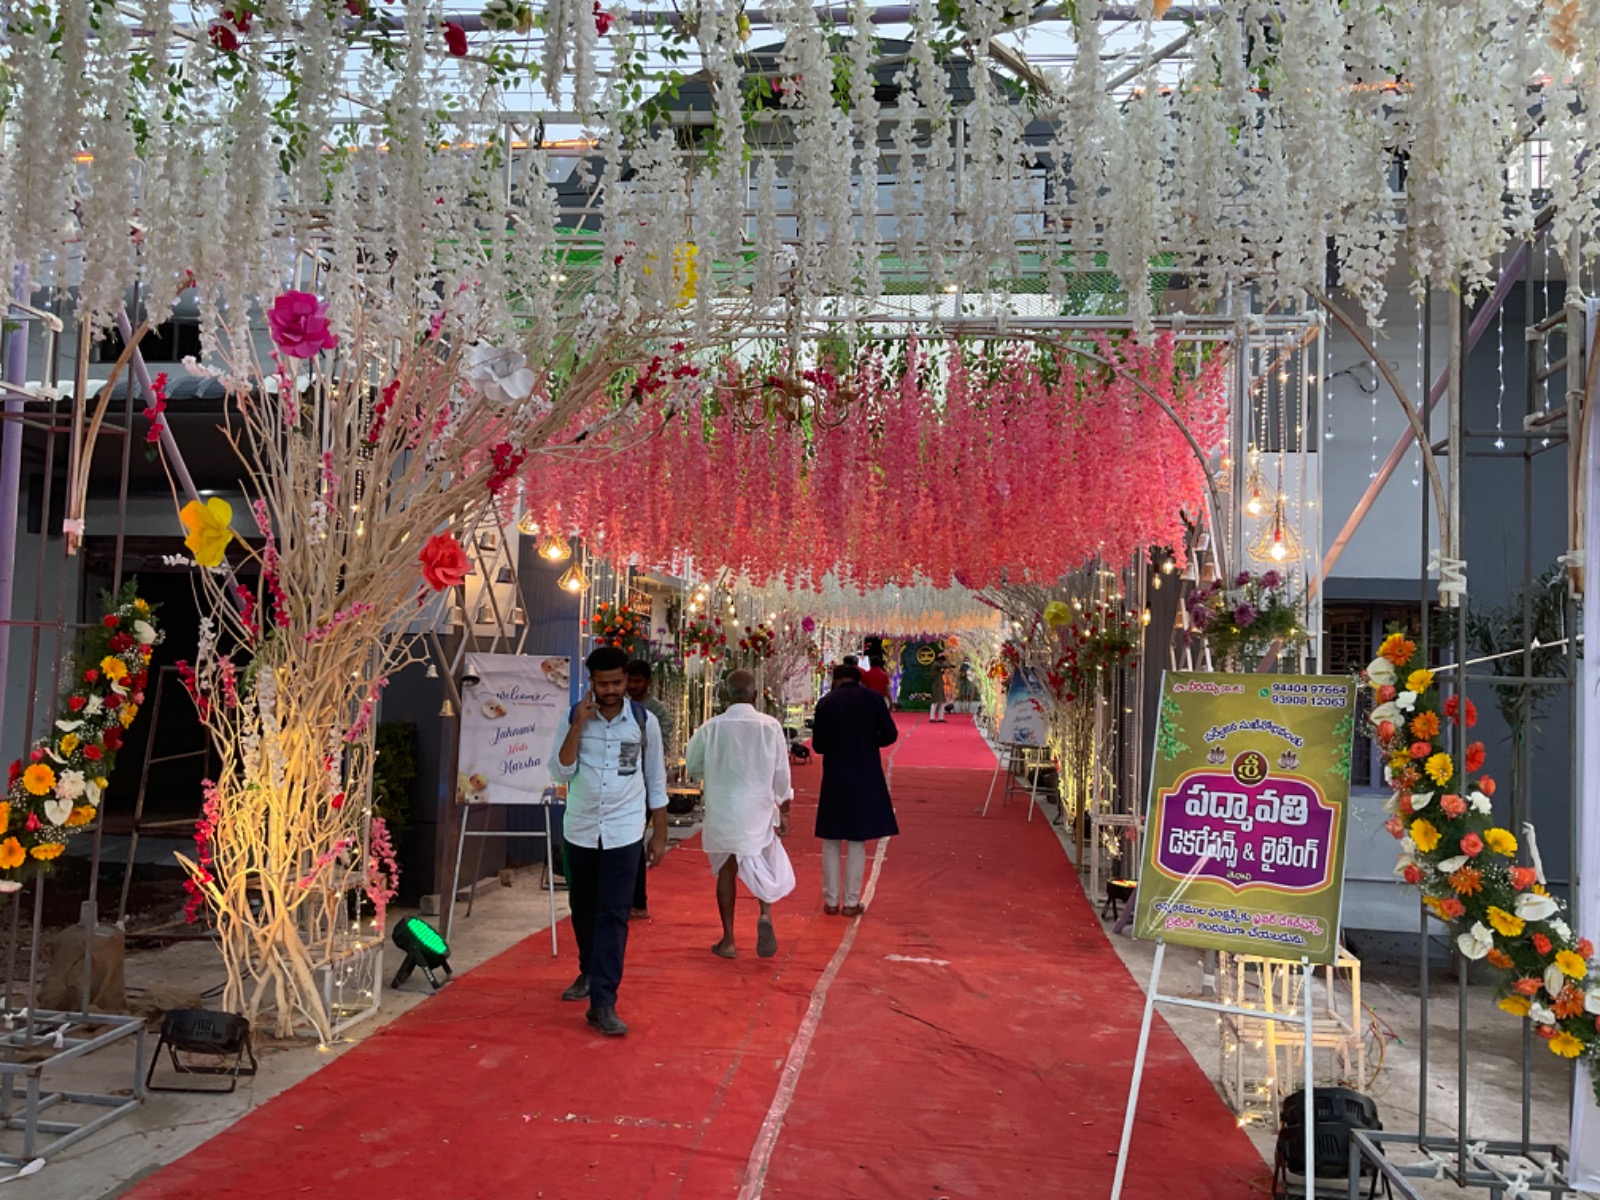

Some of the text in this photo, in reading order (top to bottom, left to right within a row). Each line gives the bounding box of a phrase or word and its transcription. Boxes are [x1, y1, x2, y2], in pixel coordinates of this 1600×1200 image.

[1272, 683, 1347, 694] 94404 97664
[1310, 697, 1346, 706] 12063
[498, 756, 542, 776] Harsha
[1242, 842, 1256, 862] &
[1261, 836, 1320, 873] లైటింగ్
